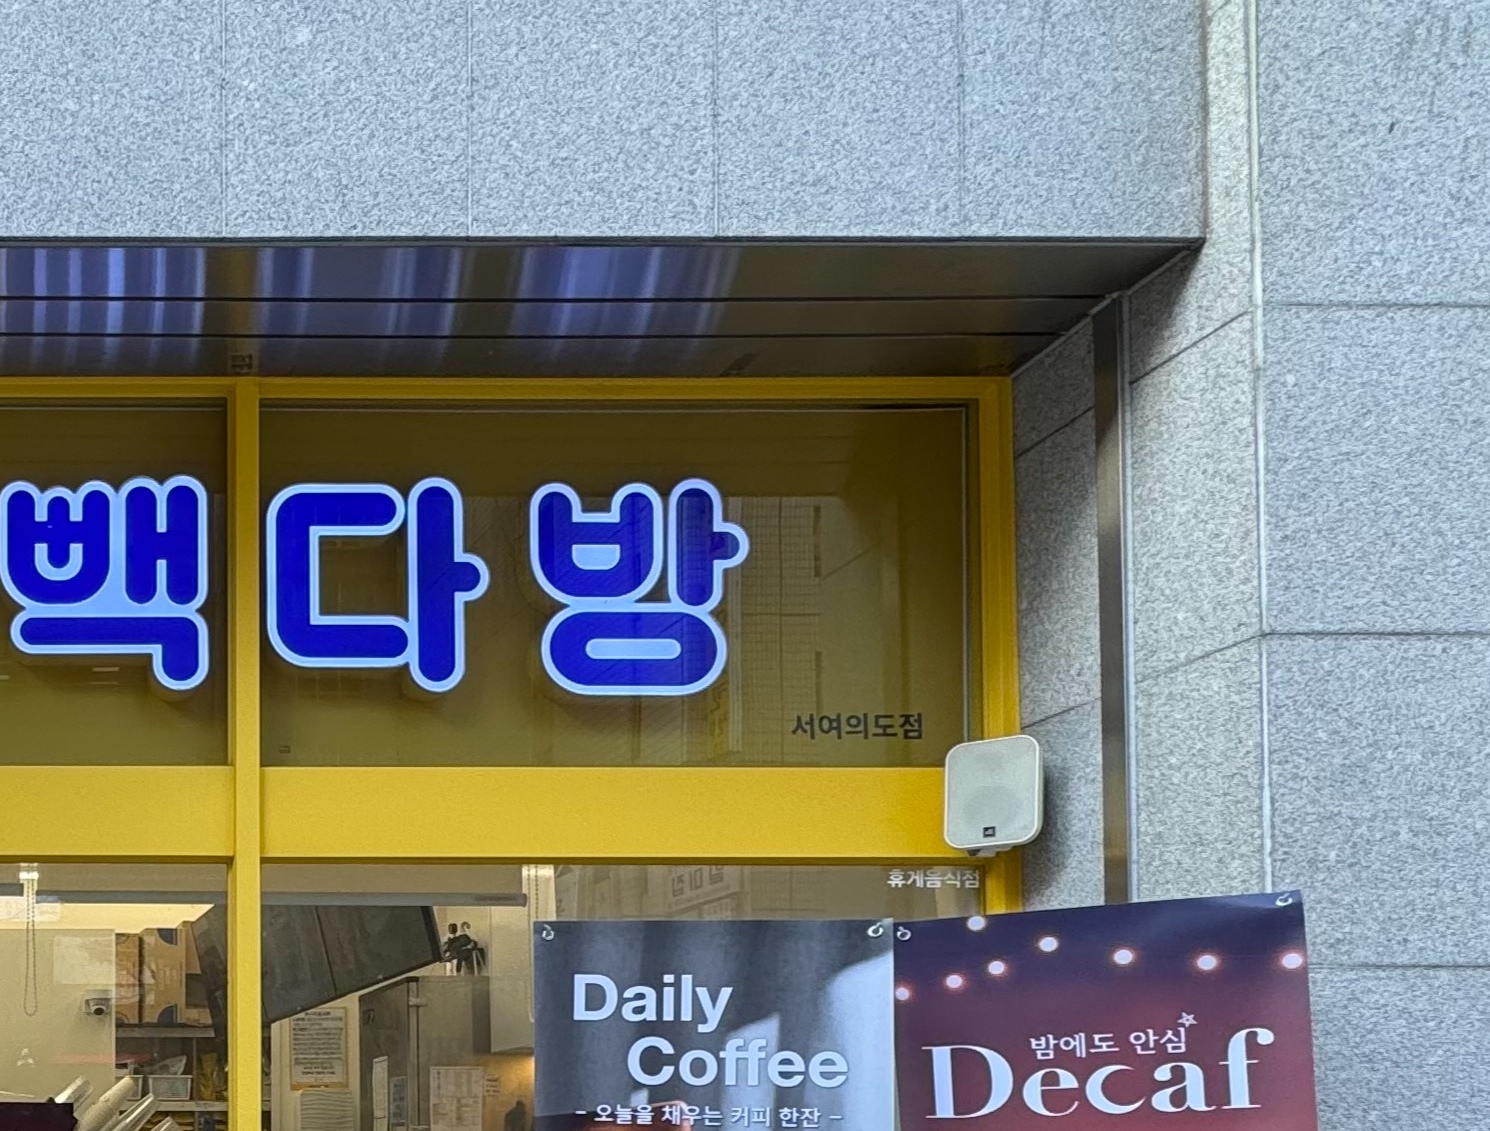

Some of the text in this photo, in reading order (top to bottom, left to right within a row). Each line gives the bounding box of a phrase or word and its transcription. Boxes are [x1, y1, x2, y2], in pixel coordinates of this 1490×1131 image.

[792, 712, 923, 740] 서여의도점
[887, 869, 980, 889] 휴게음식점
[573, 974, 733, 1033] Daily
[1030, 1027, 1187, 1060] 밤에도 안심
[627, 1036, 848, 1088] Coffee
[921, 1027, 1275, 1119] Decaf
[594, 1105, 821, 1128] 오늘을 채우는 커피 한잔
